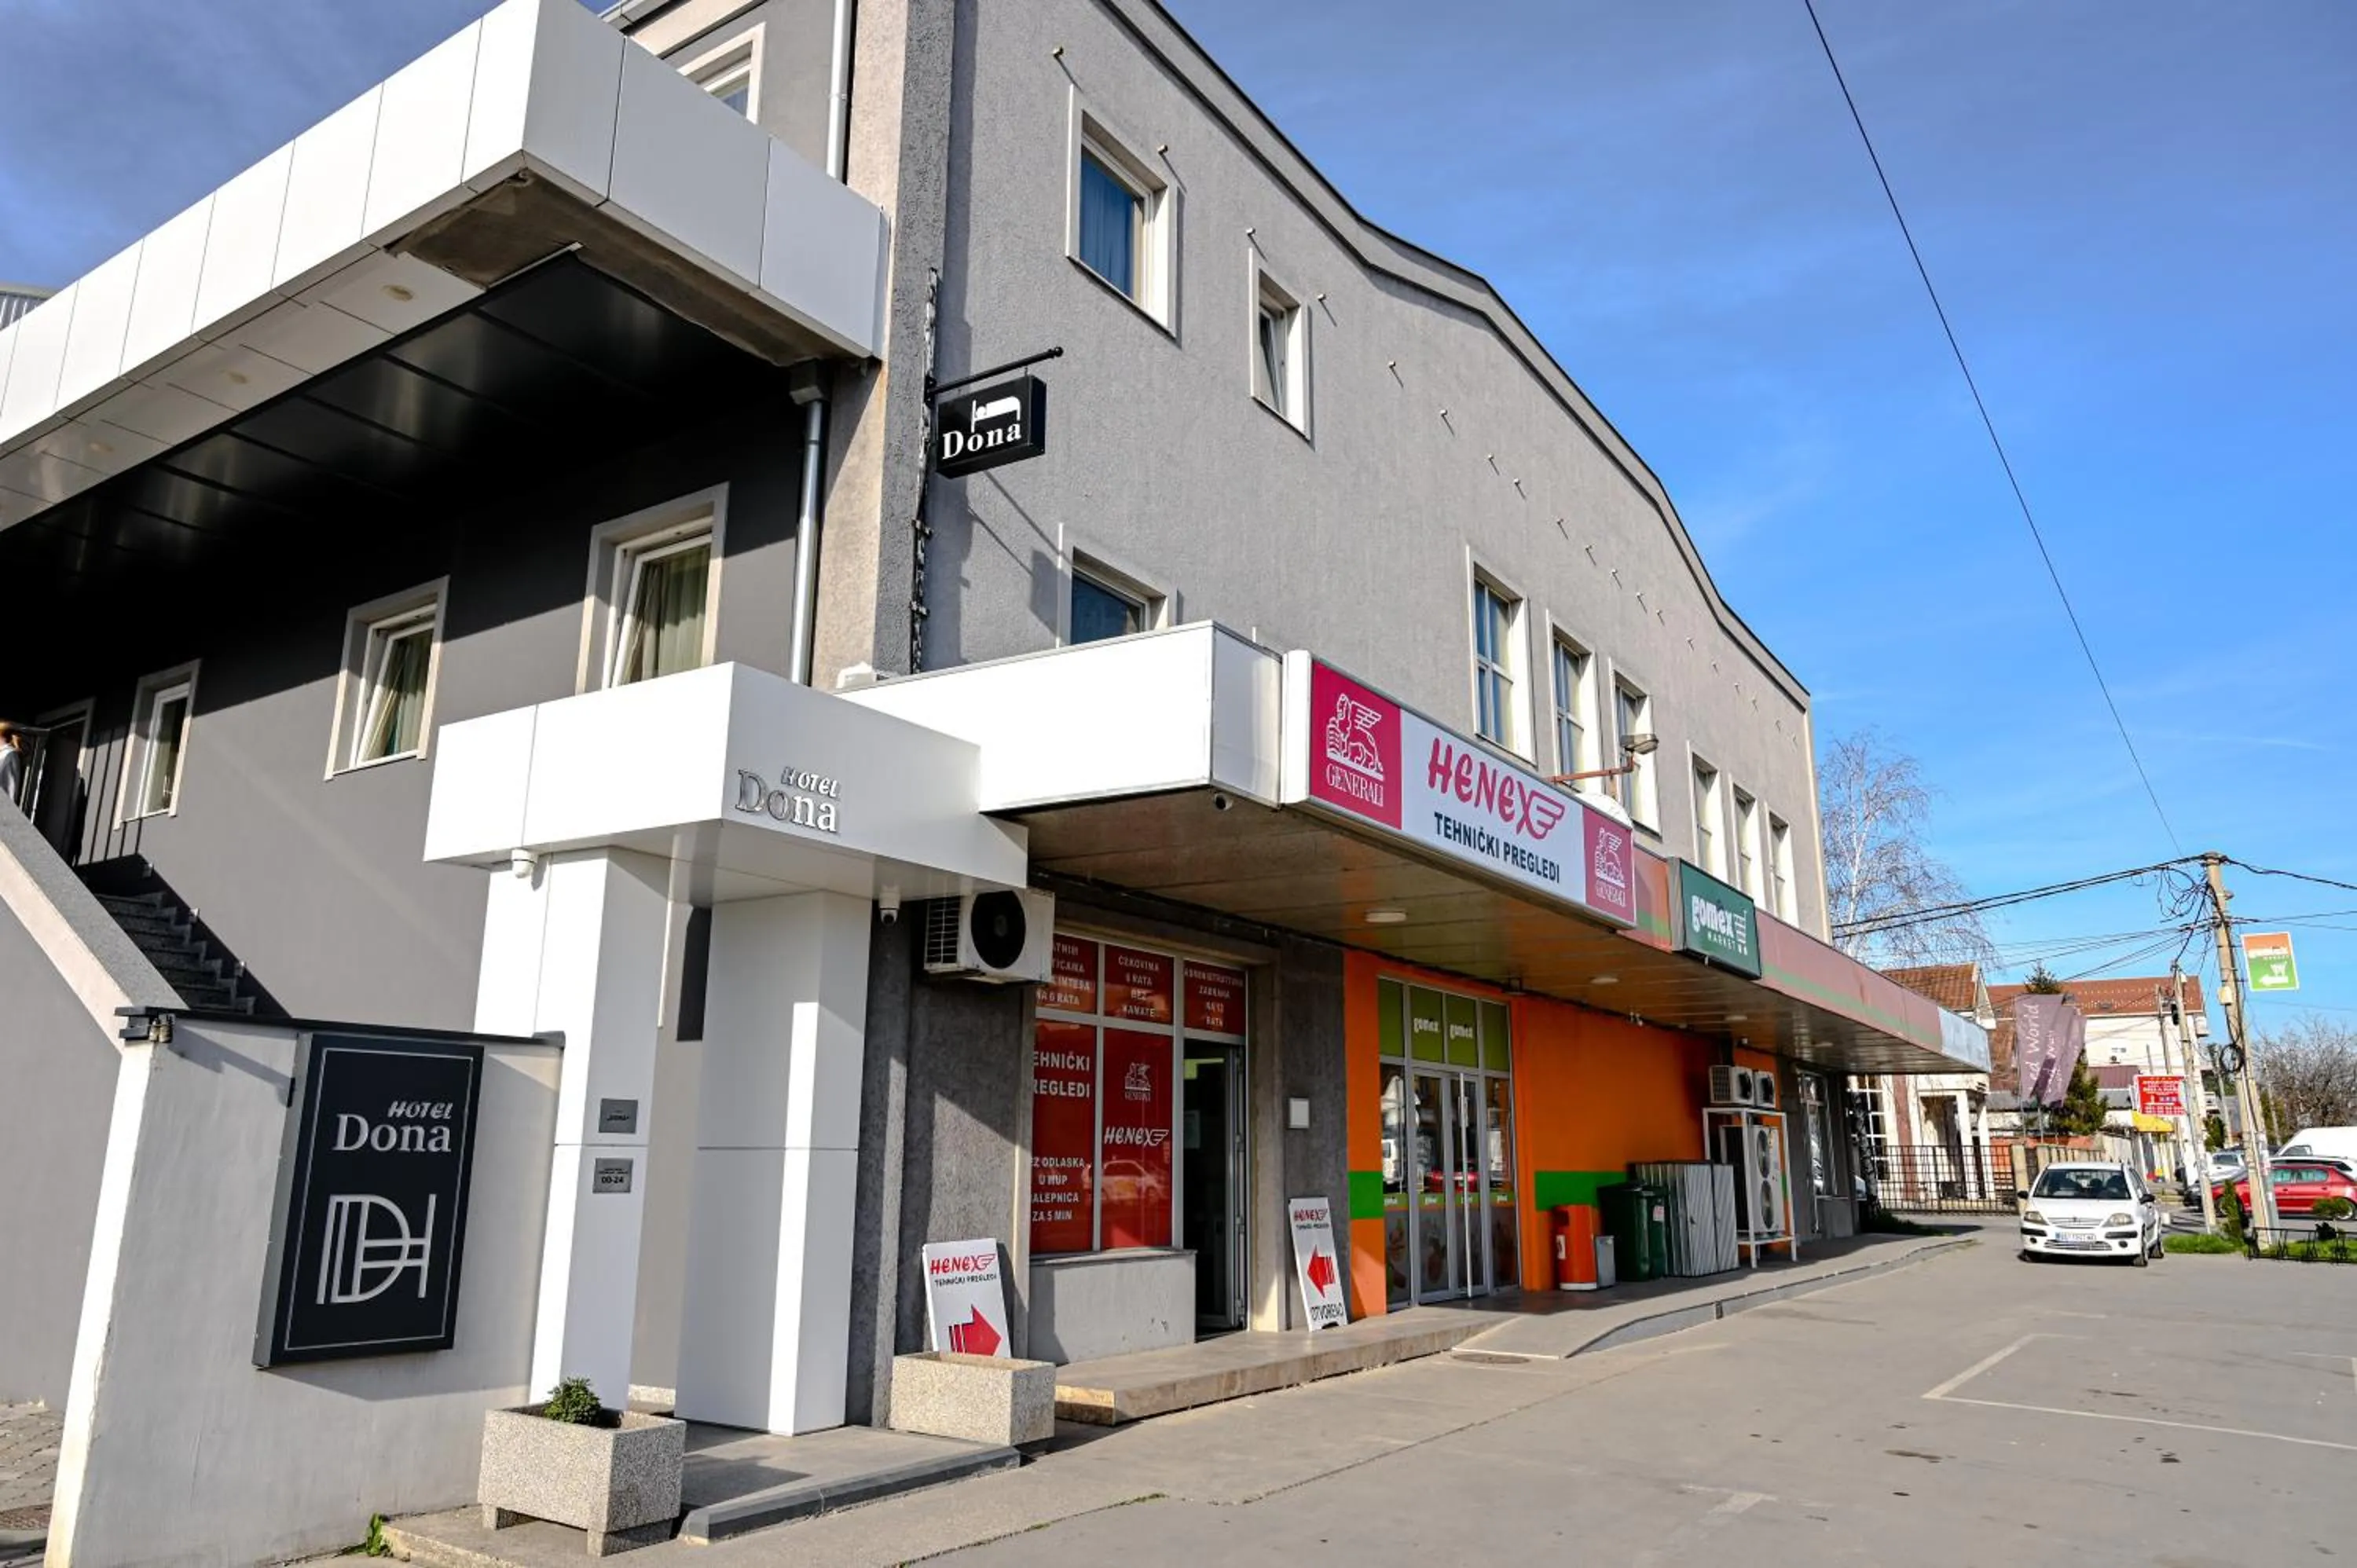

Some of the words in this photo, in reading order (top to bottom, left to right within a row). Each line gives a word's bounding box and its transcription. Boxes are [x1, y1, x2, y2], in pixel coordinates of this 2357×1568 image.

[942, 422, 1022, 460] Dona
[735, 769, 838, 833] Dona
[1325, 763, 1384, 808] GENERALI
[1428, 737, 1566, 840] HENEX
[1434, 811, 1500, 859] TEHNIČKI
[1503, 841, 1560, 884] PREGLEDI
[2023, 1003, 2040, 1053] World
[332, 1113, 452, 1153] Dona
[1104, 1126, 1170, 1147] HENEX
[1041, 1157, 1086, 1168] ODLASKA
[1032, 1210, 1045, 1222] ZA
[929, 1253, 996, 1275] HENEX
